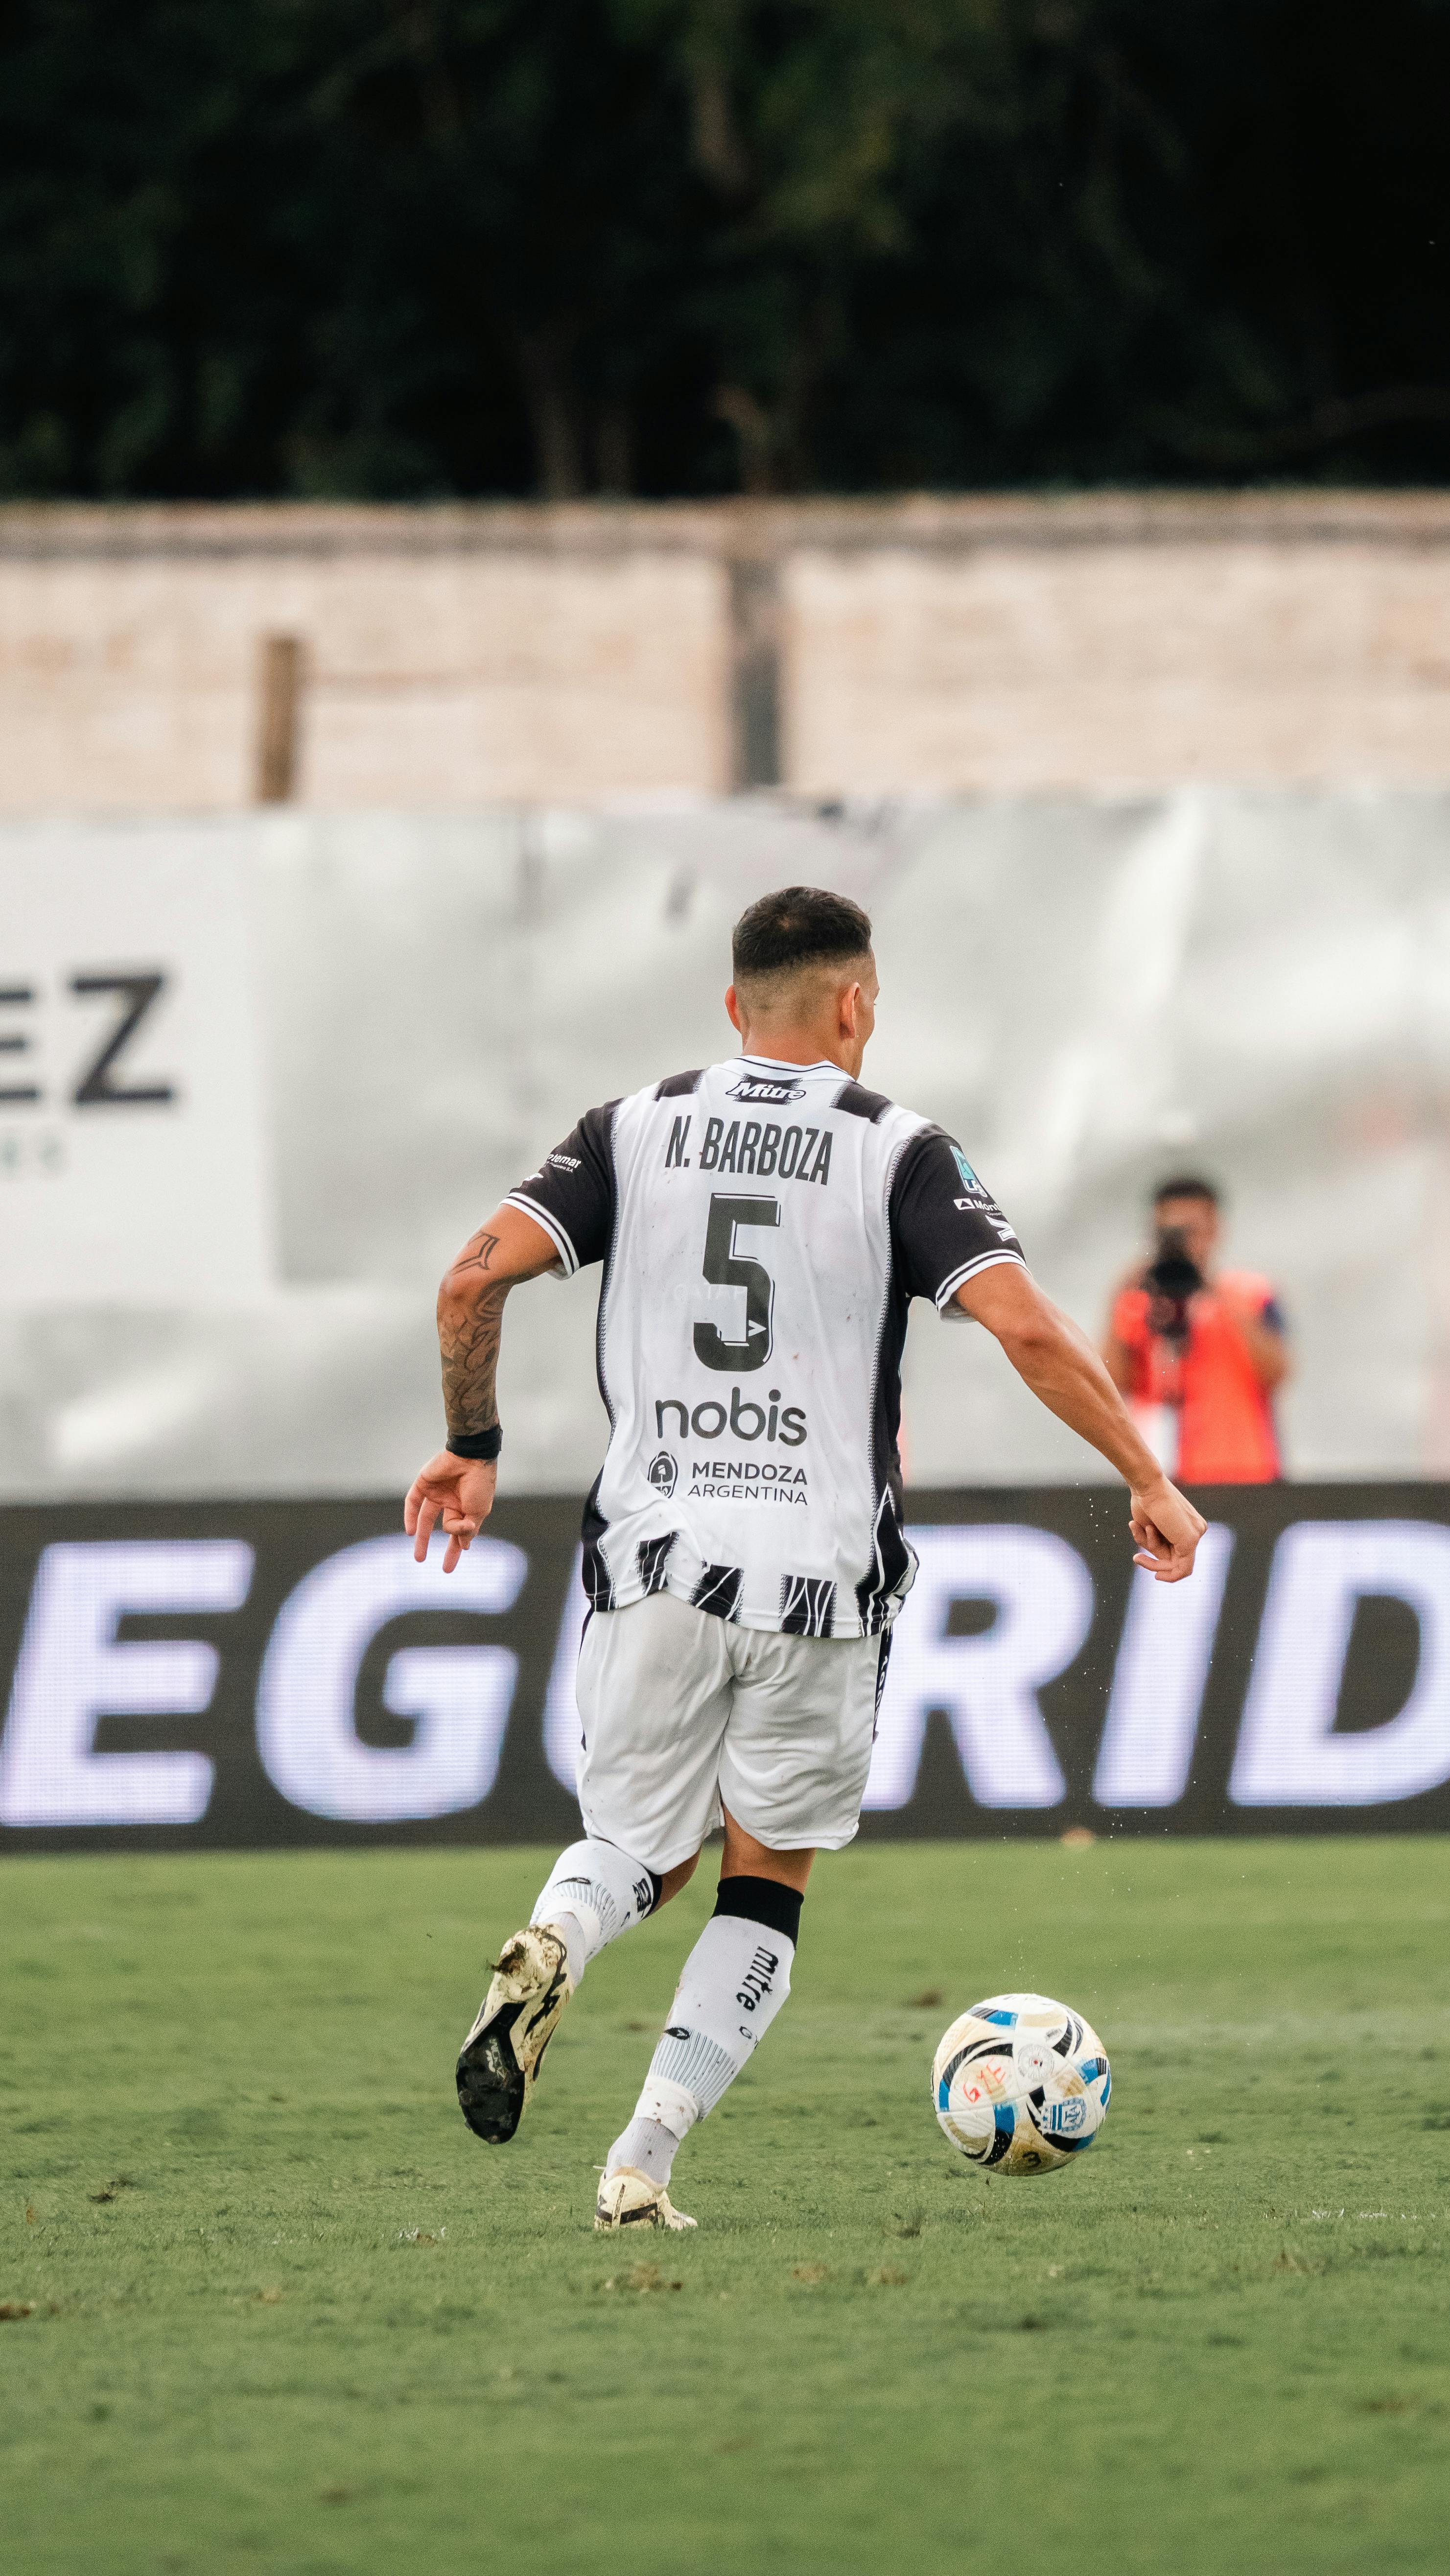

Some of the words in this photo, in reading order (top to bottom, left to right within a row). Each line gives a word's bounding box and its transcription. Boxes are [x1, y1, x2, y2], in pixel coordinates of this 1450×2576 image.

[726, 1082, 806, 1100] Mitre
[665, 1115, 691, 1168] N.
[699, 1117, 833, 1185] BARBOZA
[973, 1200, 1002, 1211] Mont
[693, 1192, 781, 1372] 5
[655, 1387, 807, 1446] nobis
[687, 1484, 808, 1505] ARGENTINA
[692, 1461, 808, 1485] MENDOZA
[0, 1519, 1450, 1827] EGRID
[736, 1946, 779, 2011] mitre
